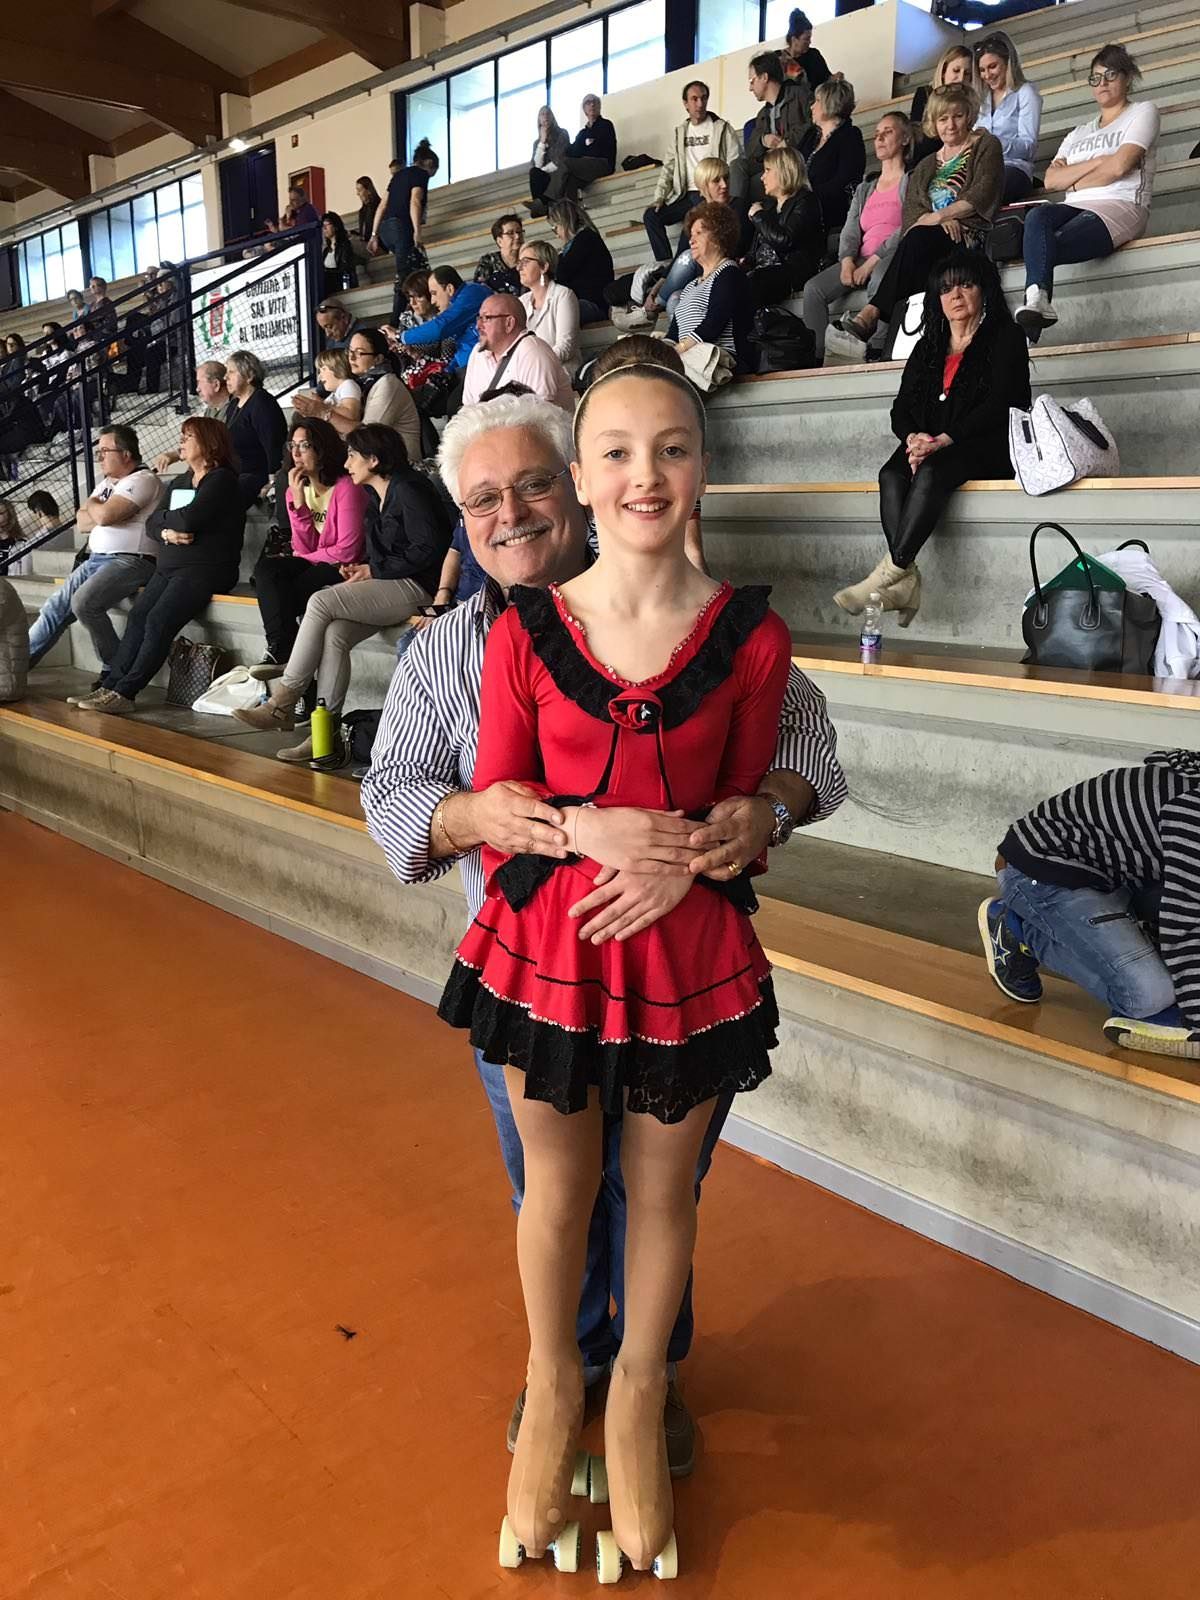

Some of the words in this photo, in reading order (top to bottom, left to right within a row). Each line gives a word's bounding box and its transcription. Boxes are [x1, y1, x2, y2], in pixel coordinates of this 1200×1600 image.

[250, 301, 264, 319] SAN
[268, 296, 287, 314] VITO
[251, 316, 299, 341] TAGLIAMENT
